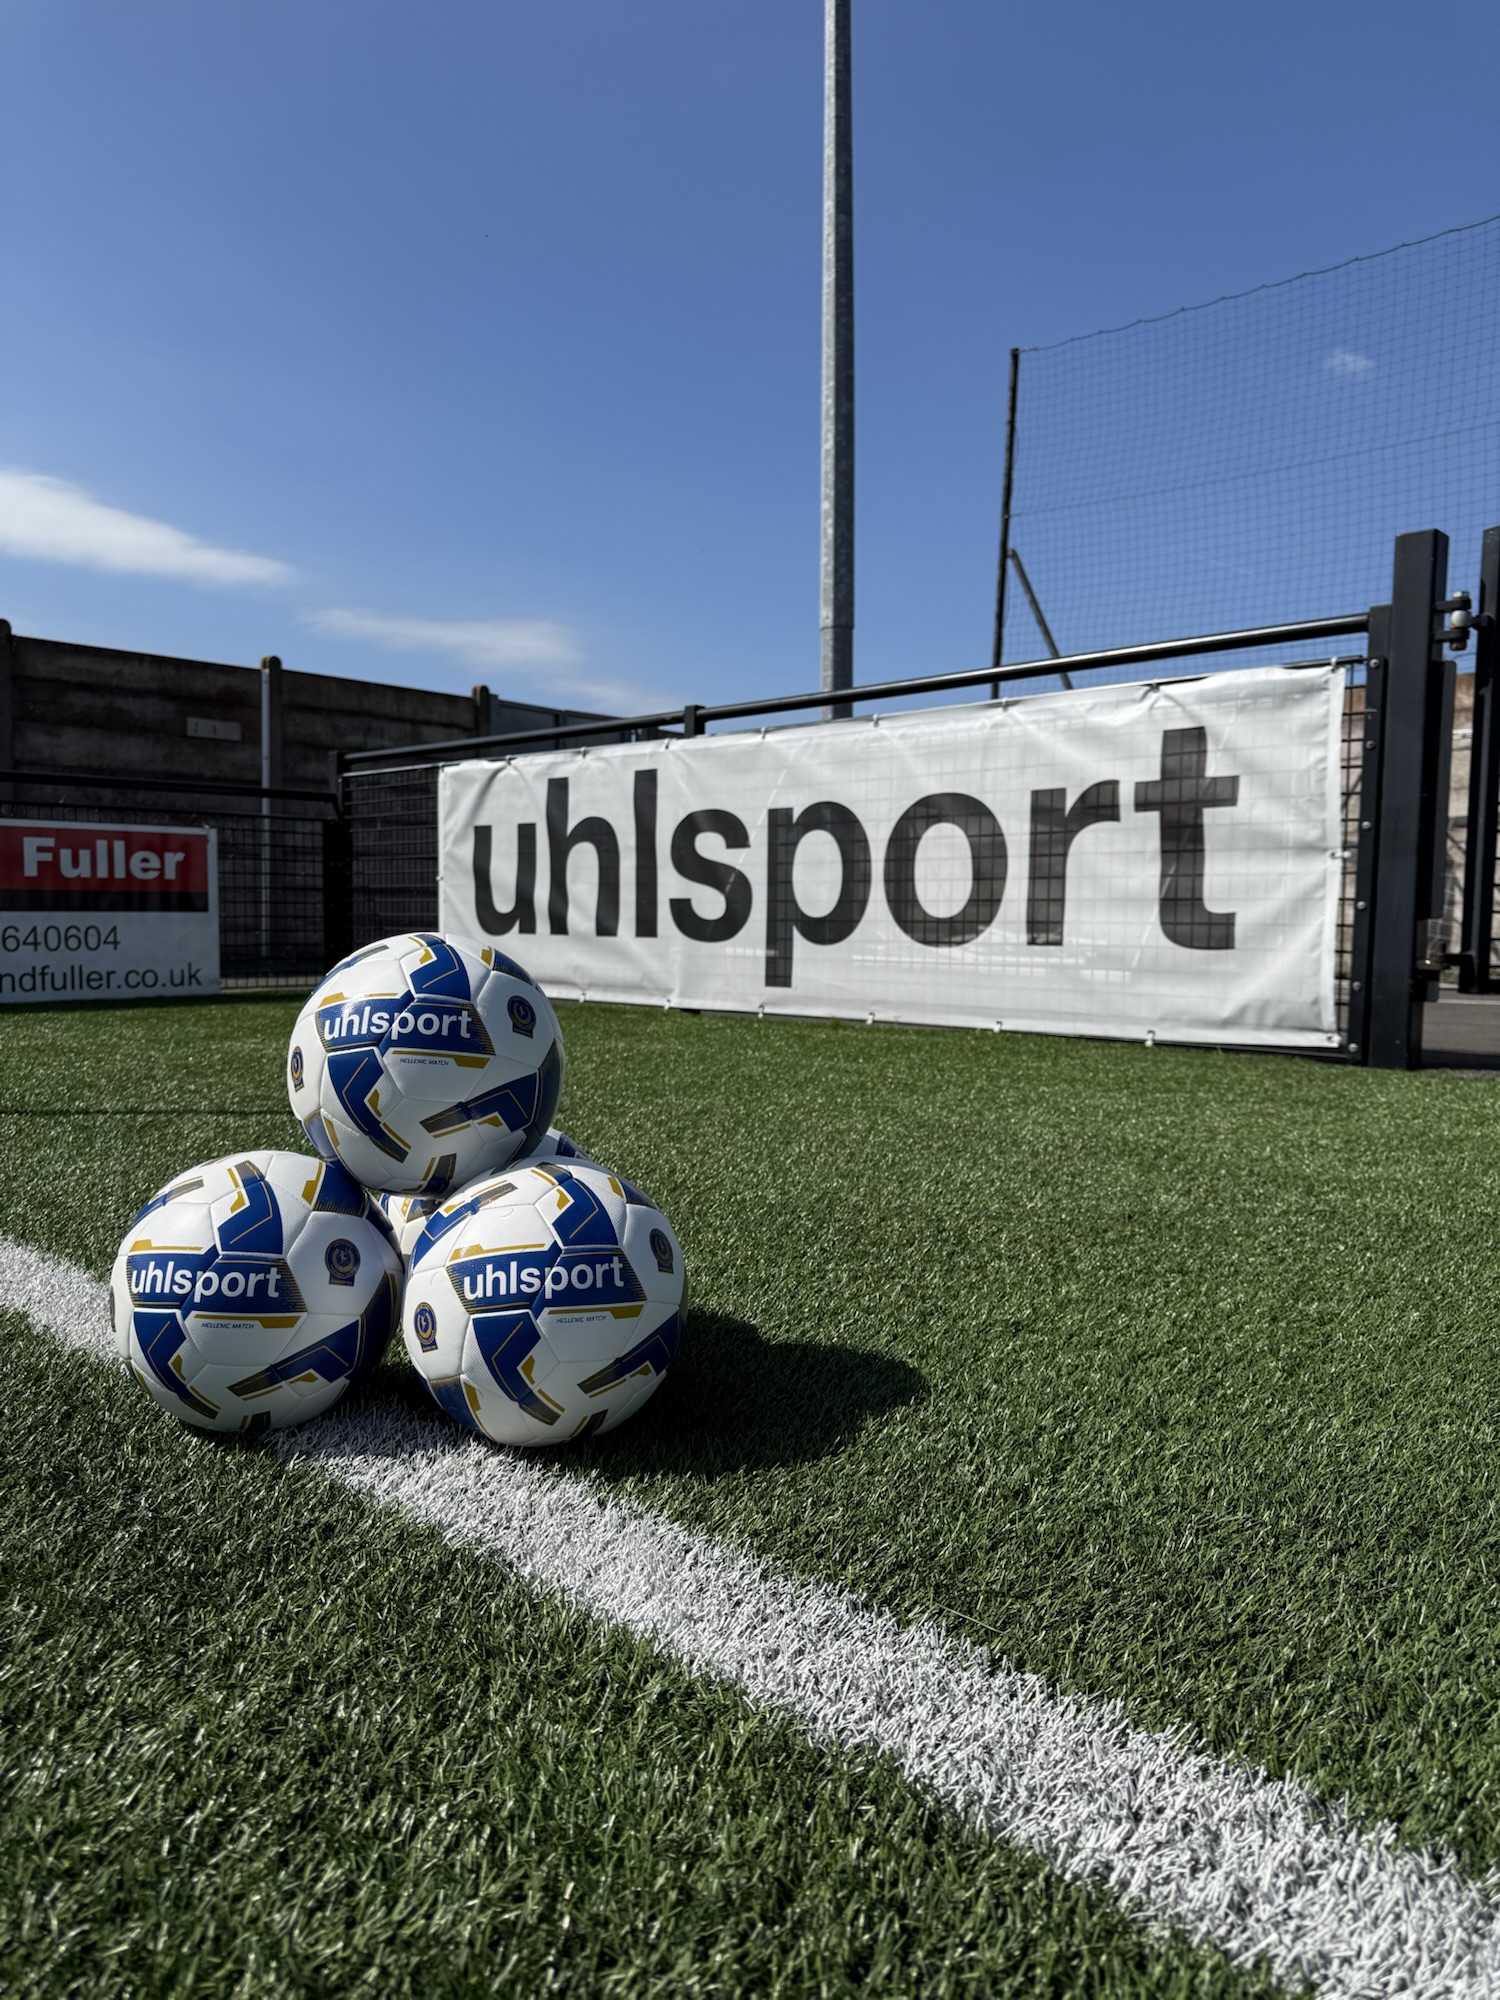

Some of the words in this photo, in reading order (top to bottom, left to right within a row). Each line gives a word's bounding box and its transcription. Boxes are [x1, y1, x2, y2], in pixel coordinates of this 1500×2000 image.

[23, 836, 186, 880] Fuller
[473, 727, 1239, 988] uhlsport
[1, 925, 120, 952] 640604
[324, 1006, 473, 1040] uhlsport
[132, 1261, 281, 1303] uhlsport
[463, 1256, 625, 1299] uhlsport
[585, 1314, 607, 1322] MATCH
